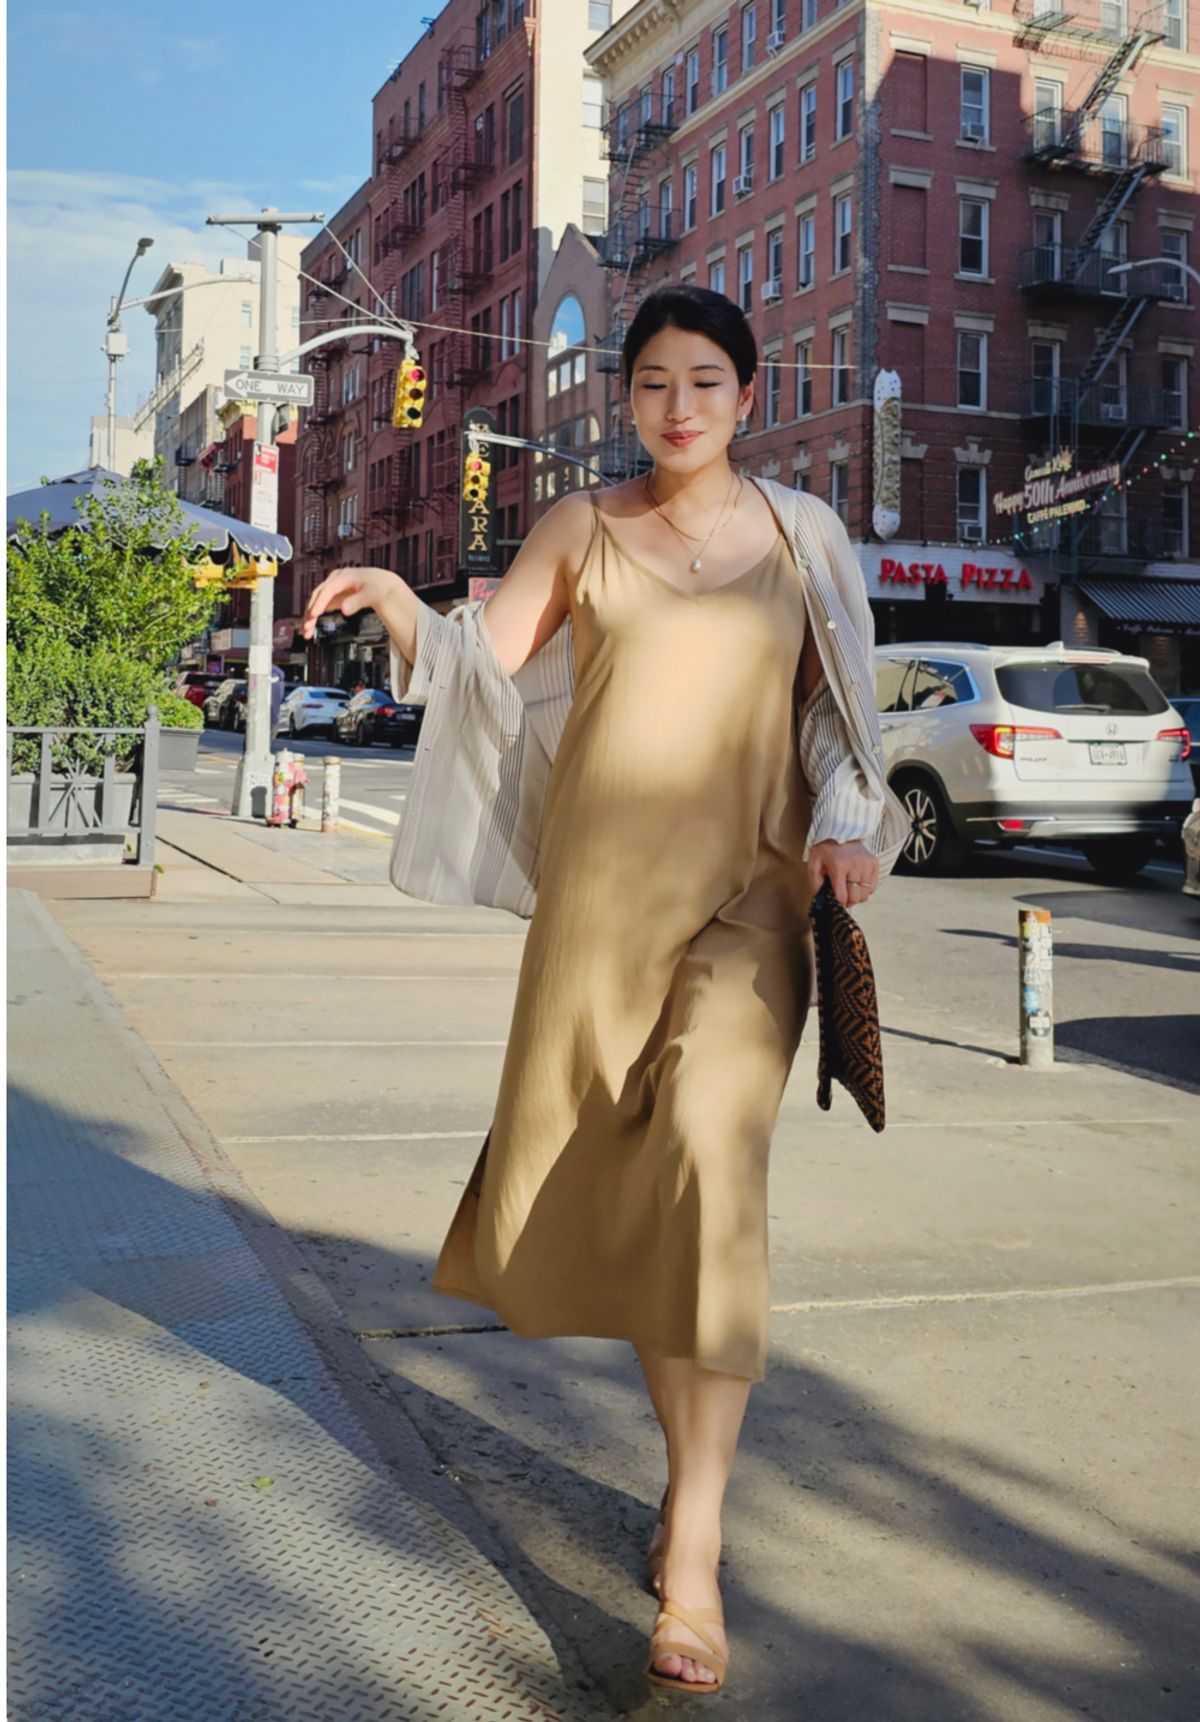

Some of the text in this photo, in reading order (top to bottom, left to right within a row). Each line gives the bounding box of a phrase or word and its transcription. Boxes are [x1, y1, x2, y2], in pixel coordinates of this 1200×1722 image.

[235, 378, 305, 396] ONE WAY
[993, 462, 1121, 515] Happy 50th Anniversary
